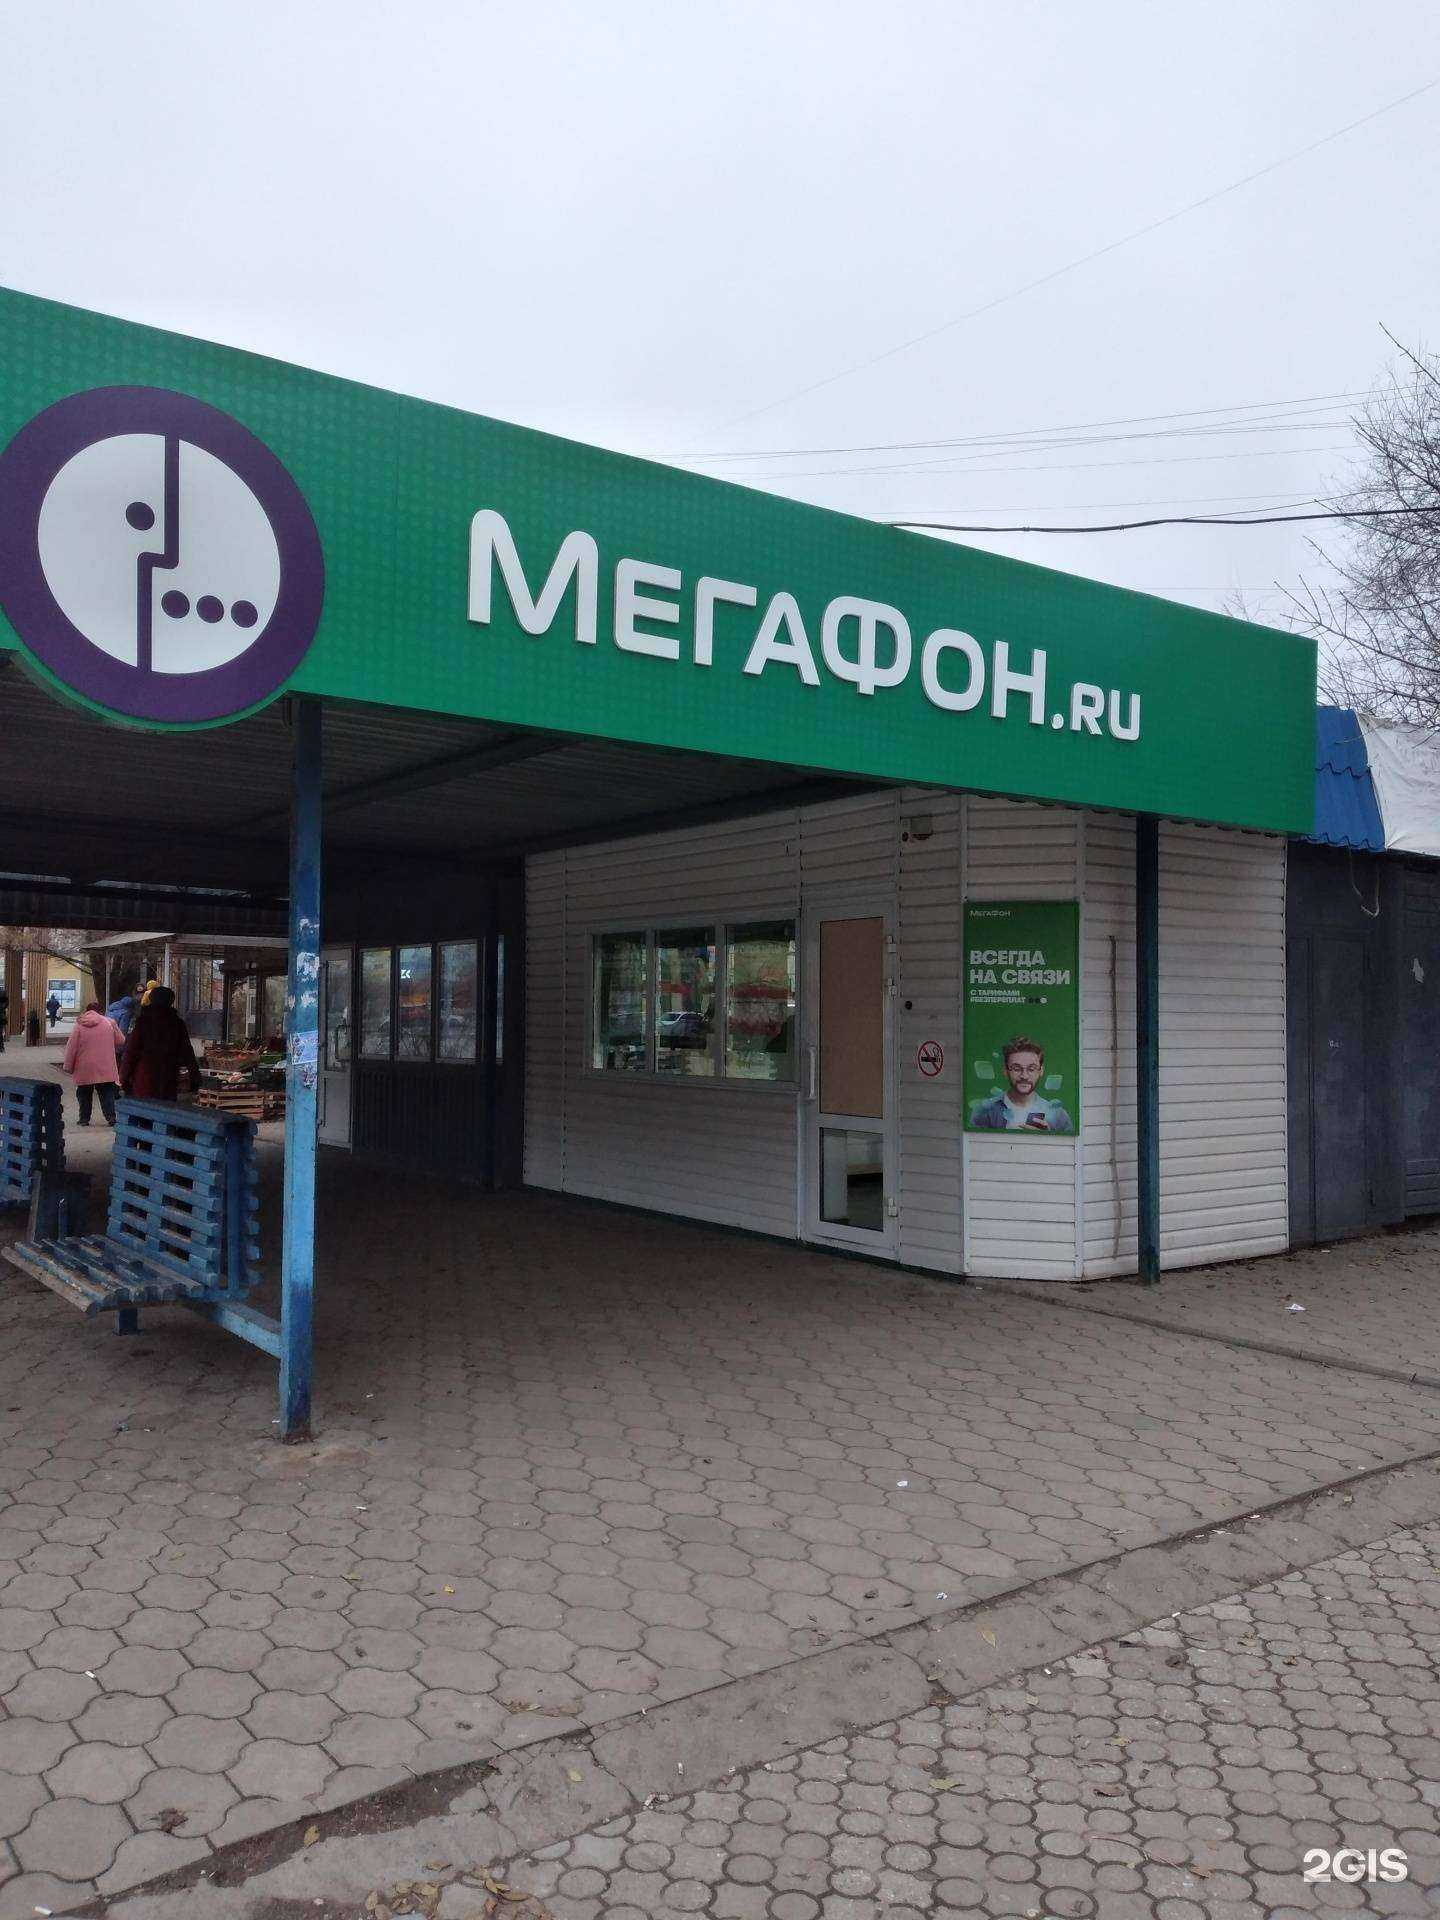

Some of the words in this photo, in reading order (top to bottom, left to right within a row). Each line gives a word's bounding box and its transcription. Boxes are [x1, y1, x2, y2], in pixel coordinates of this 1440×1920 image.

[970, 950, 1046, 967] ВСЕГДА
[970, 970, 997, 984] НА
[1002, 969, 1070, 985] СВЯЗИ
